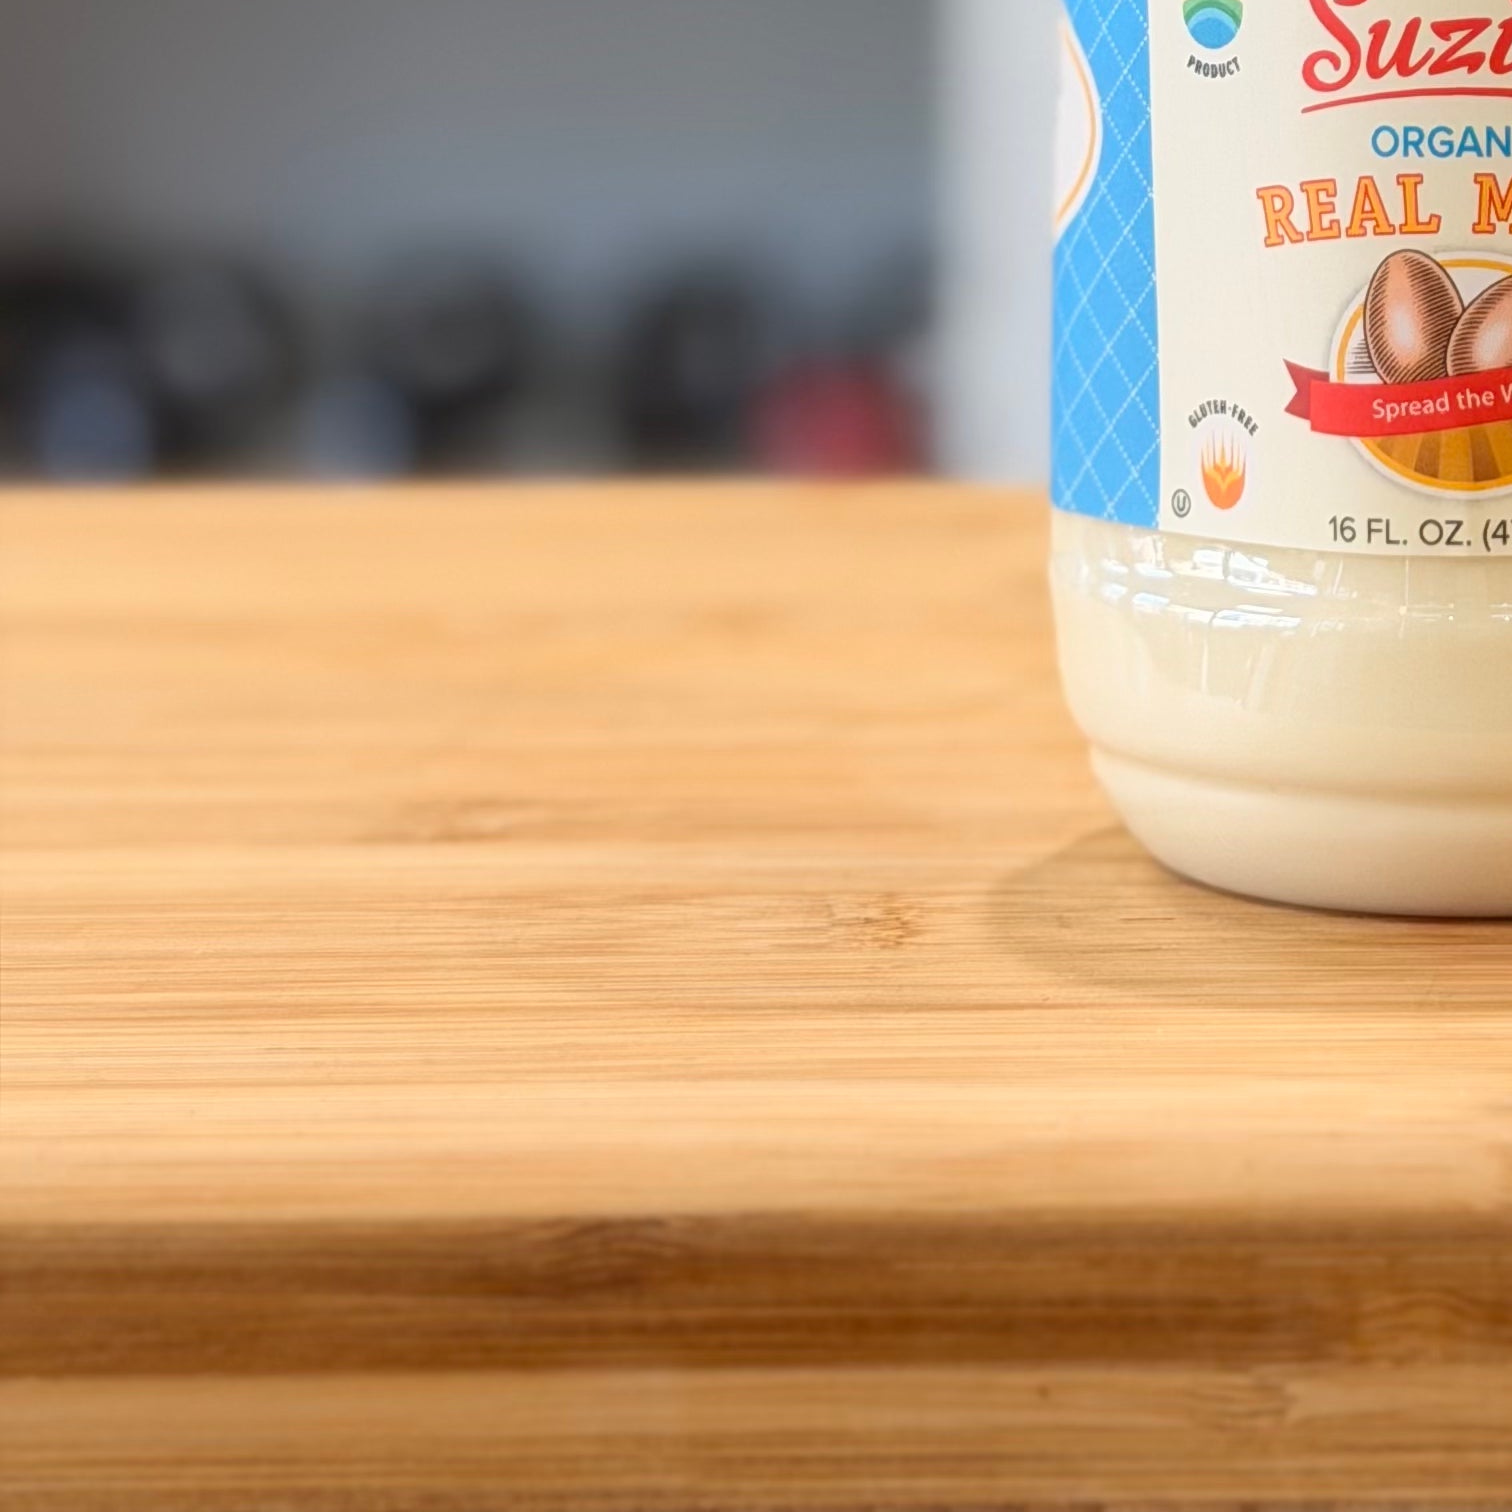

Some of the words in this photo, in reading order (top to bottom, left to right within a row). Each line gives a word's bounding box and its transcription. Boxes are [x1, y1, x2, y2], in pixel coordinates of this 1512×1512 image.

[1187, 55, 1241, 78] PRODUCT
[1256, 173, 1442, 247] REAL
[1188, 399, 1259, 437] GLUTEN-FREE
[1372, 390, 1450, 422] Spread
[1456, 385, 1495, 409] the
[1329, 516, 1356, 544] 16
[1367, 518, 1408, 545] FL.
[1419, 519, 1472, 547] OZ.
